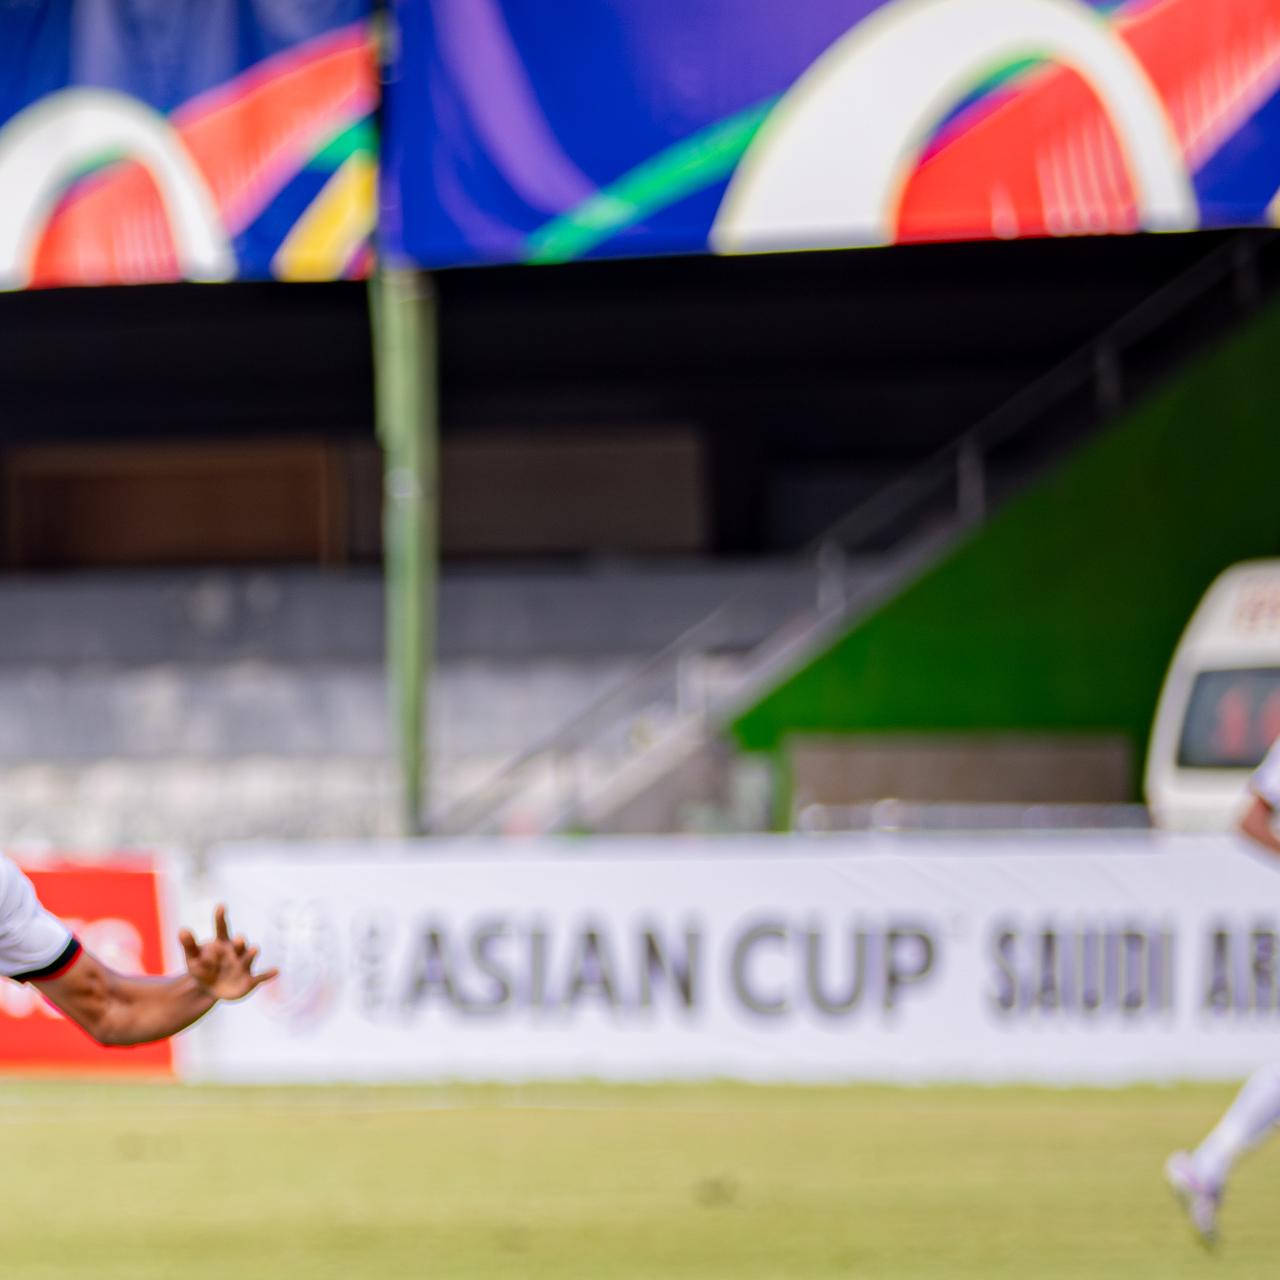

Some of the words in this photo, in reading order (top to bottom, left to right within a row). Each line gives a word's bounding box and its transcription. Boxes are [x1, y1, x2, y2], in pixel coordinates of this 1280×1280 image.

[404, 916, 704, 1022] ASIAN
[730, 915, 942, 1024] CUP
[988, 918, 1178, 1024] SAUDI
